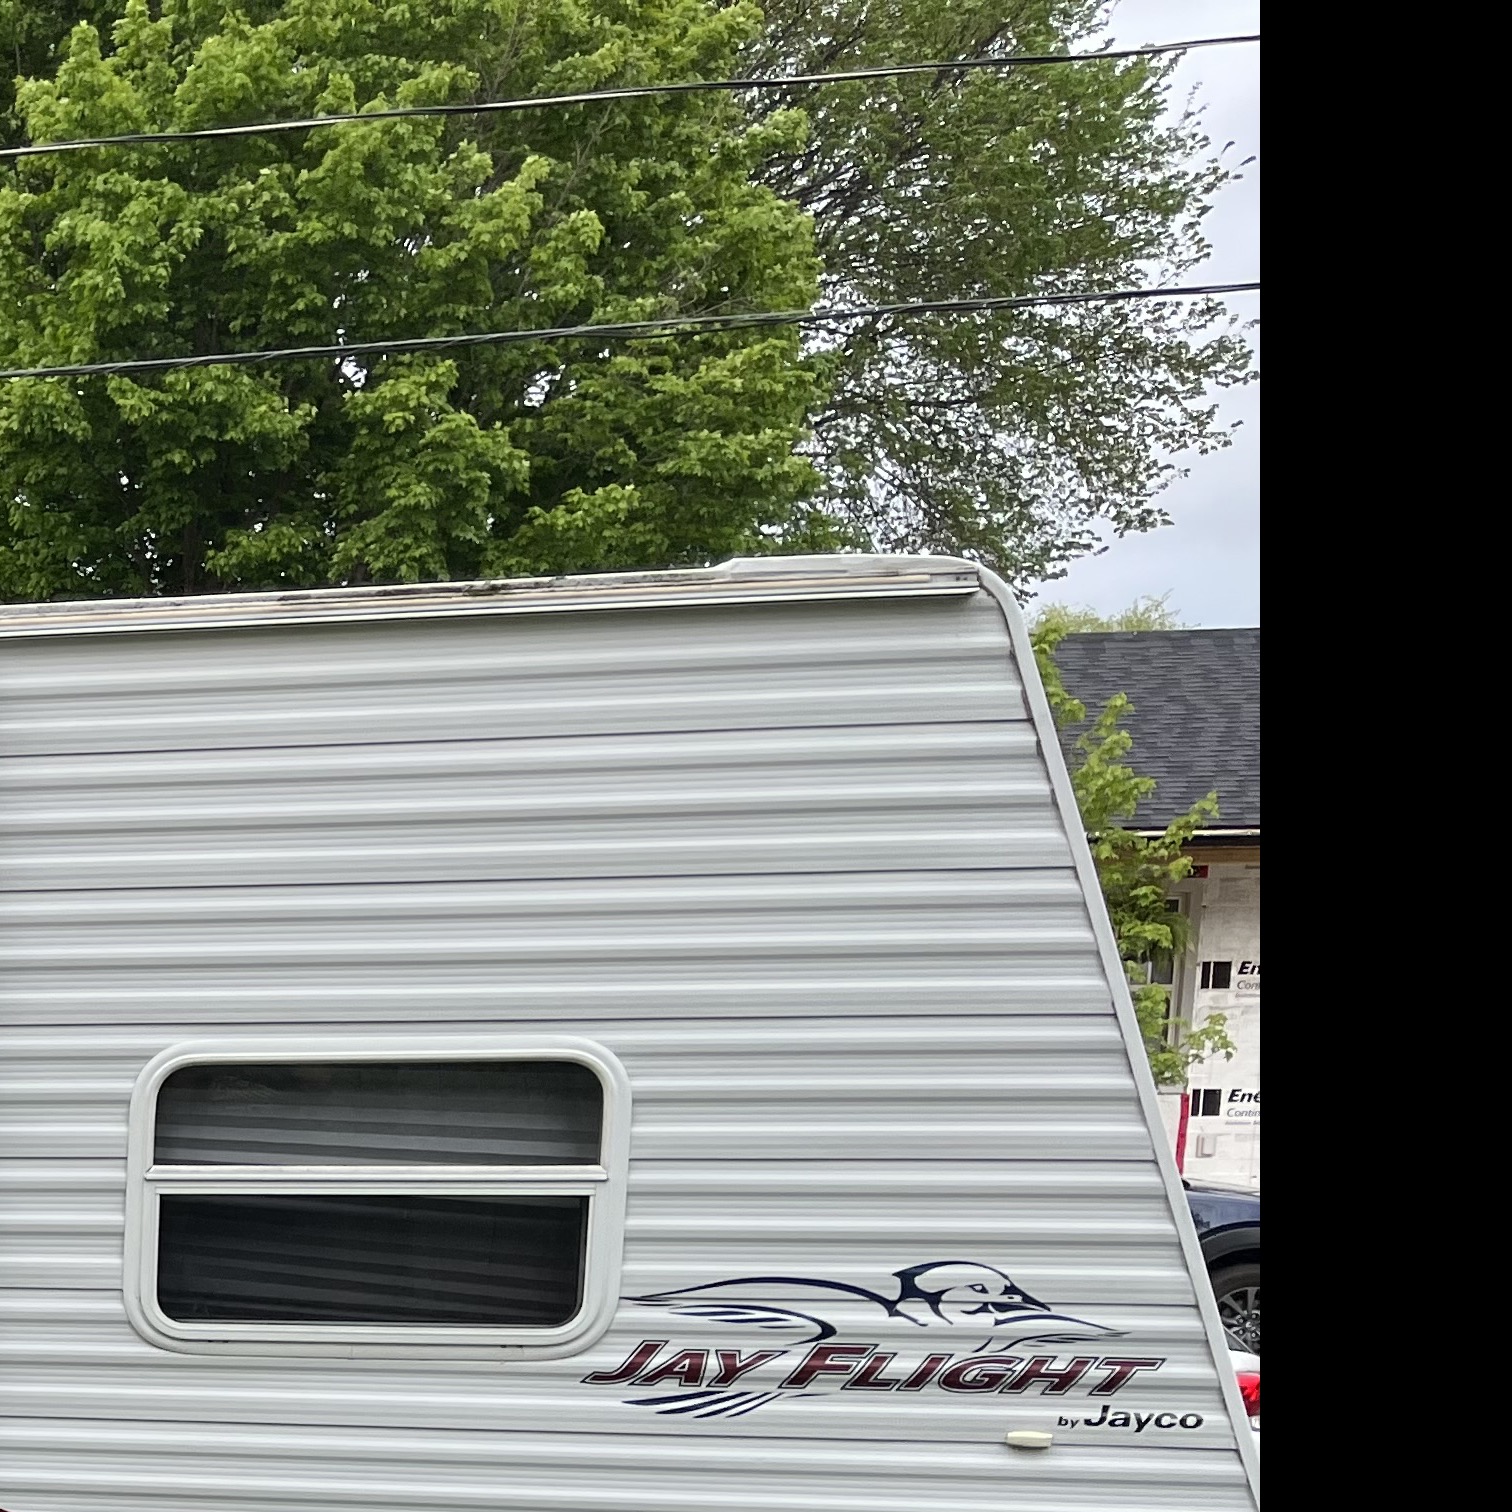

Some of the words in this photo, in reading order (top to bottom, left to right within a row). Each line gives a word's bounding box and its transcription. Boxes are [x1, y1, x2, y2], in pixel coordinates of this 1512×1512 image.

[580, 1339, 791, 1388] JAY
[777, 1343, 1167, 1397] FLIGHT
[1056, 1415, 1079, 1429] by
[1083, 1404, 1204, 1433] Jayco
